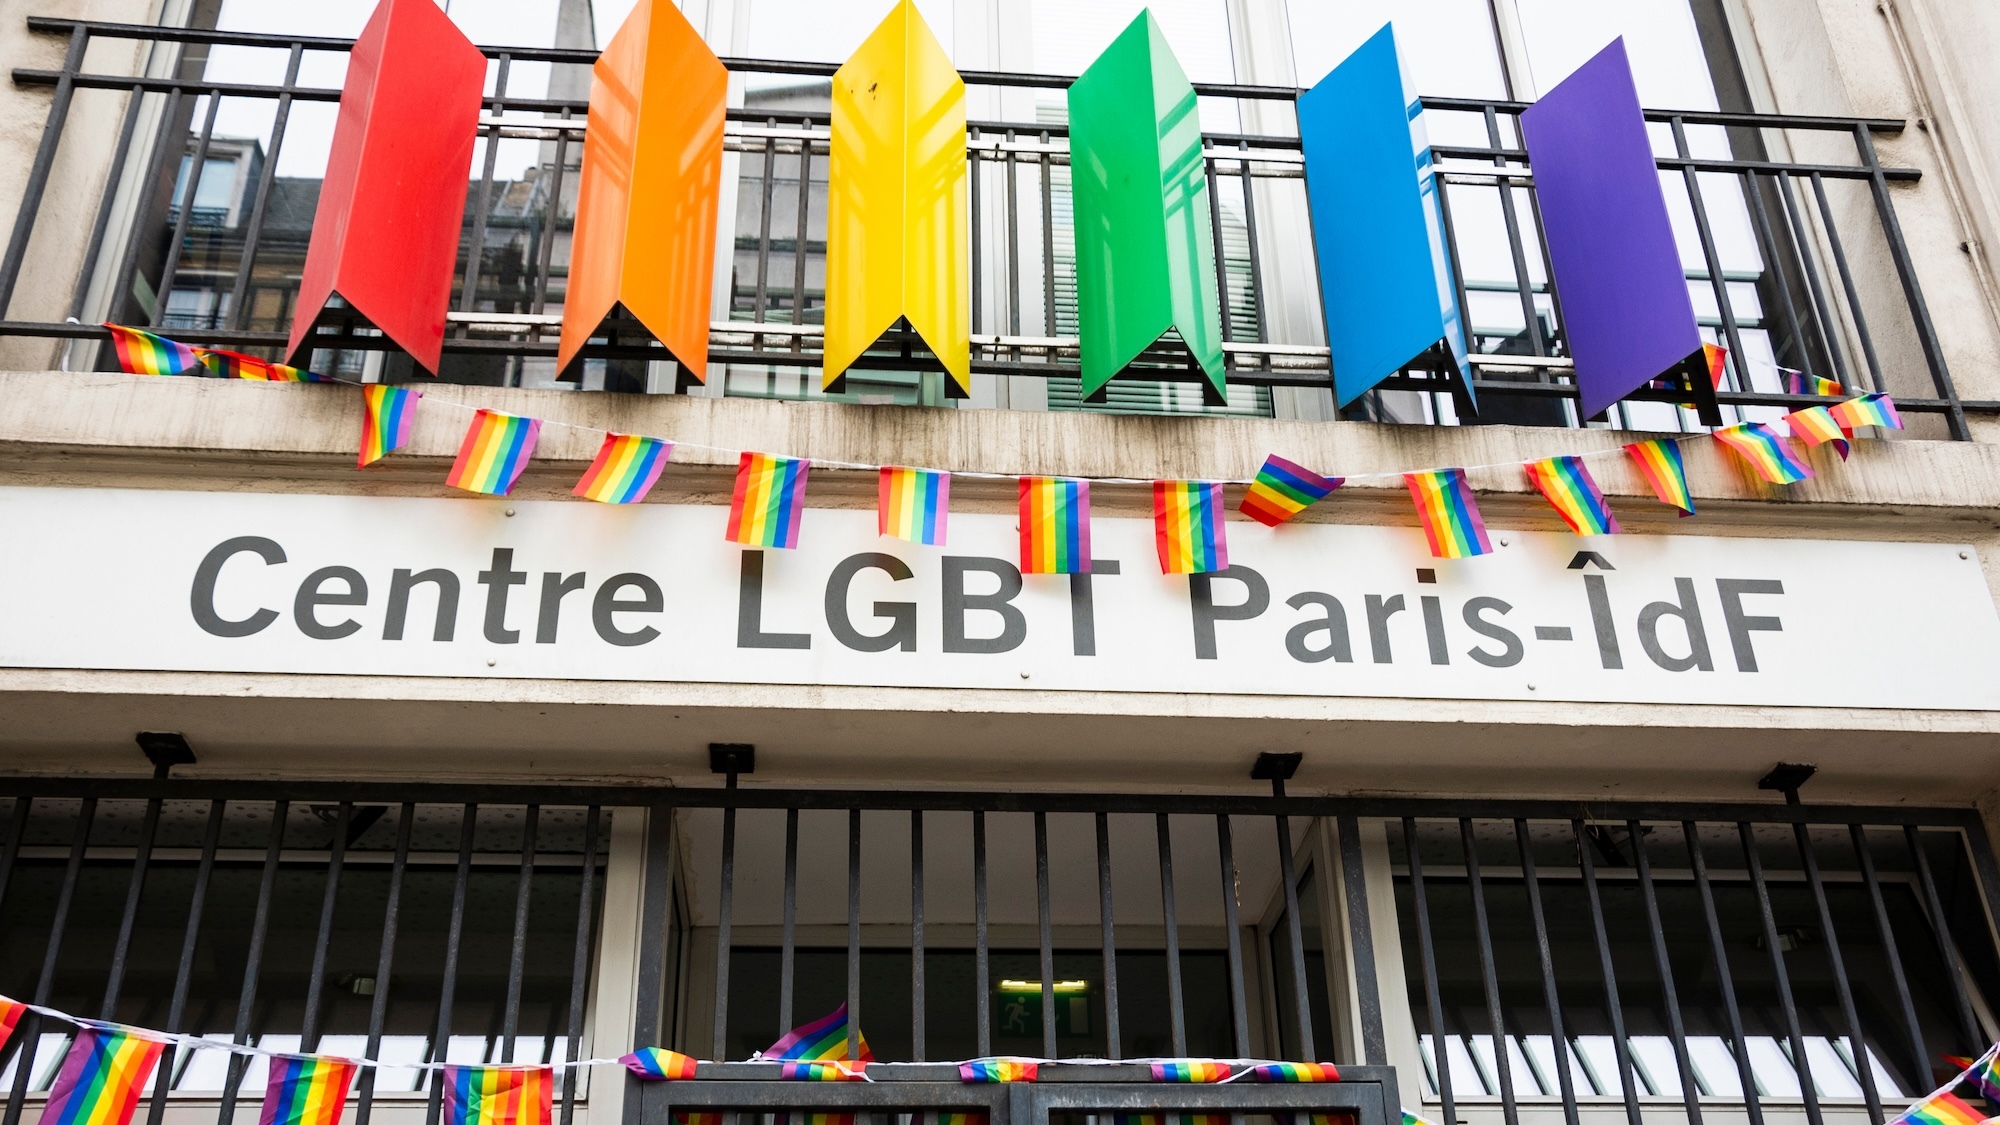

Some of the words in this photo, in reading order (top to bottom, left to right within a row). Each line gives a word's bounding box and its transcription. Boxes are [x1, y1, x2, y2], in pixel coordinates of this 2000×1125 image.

[189, 535, 665, 648] Centre
[737, 549, 1121, 657] LGBT
[1189, 550, 1785, 674] Paris-ÎdF
